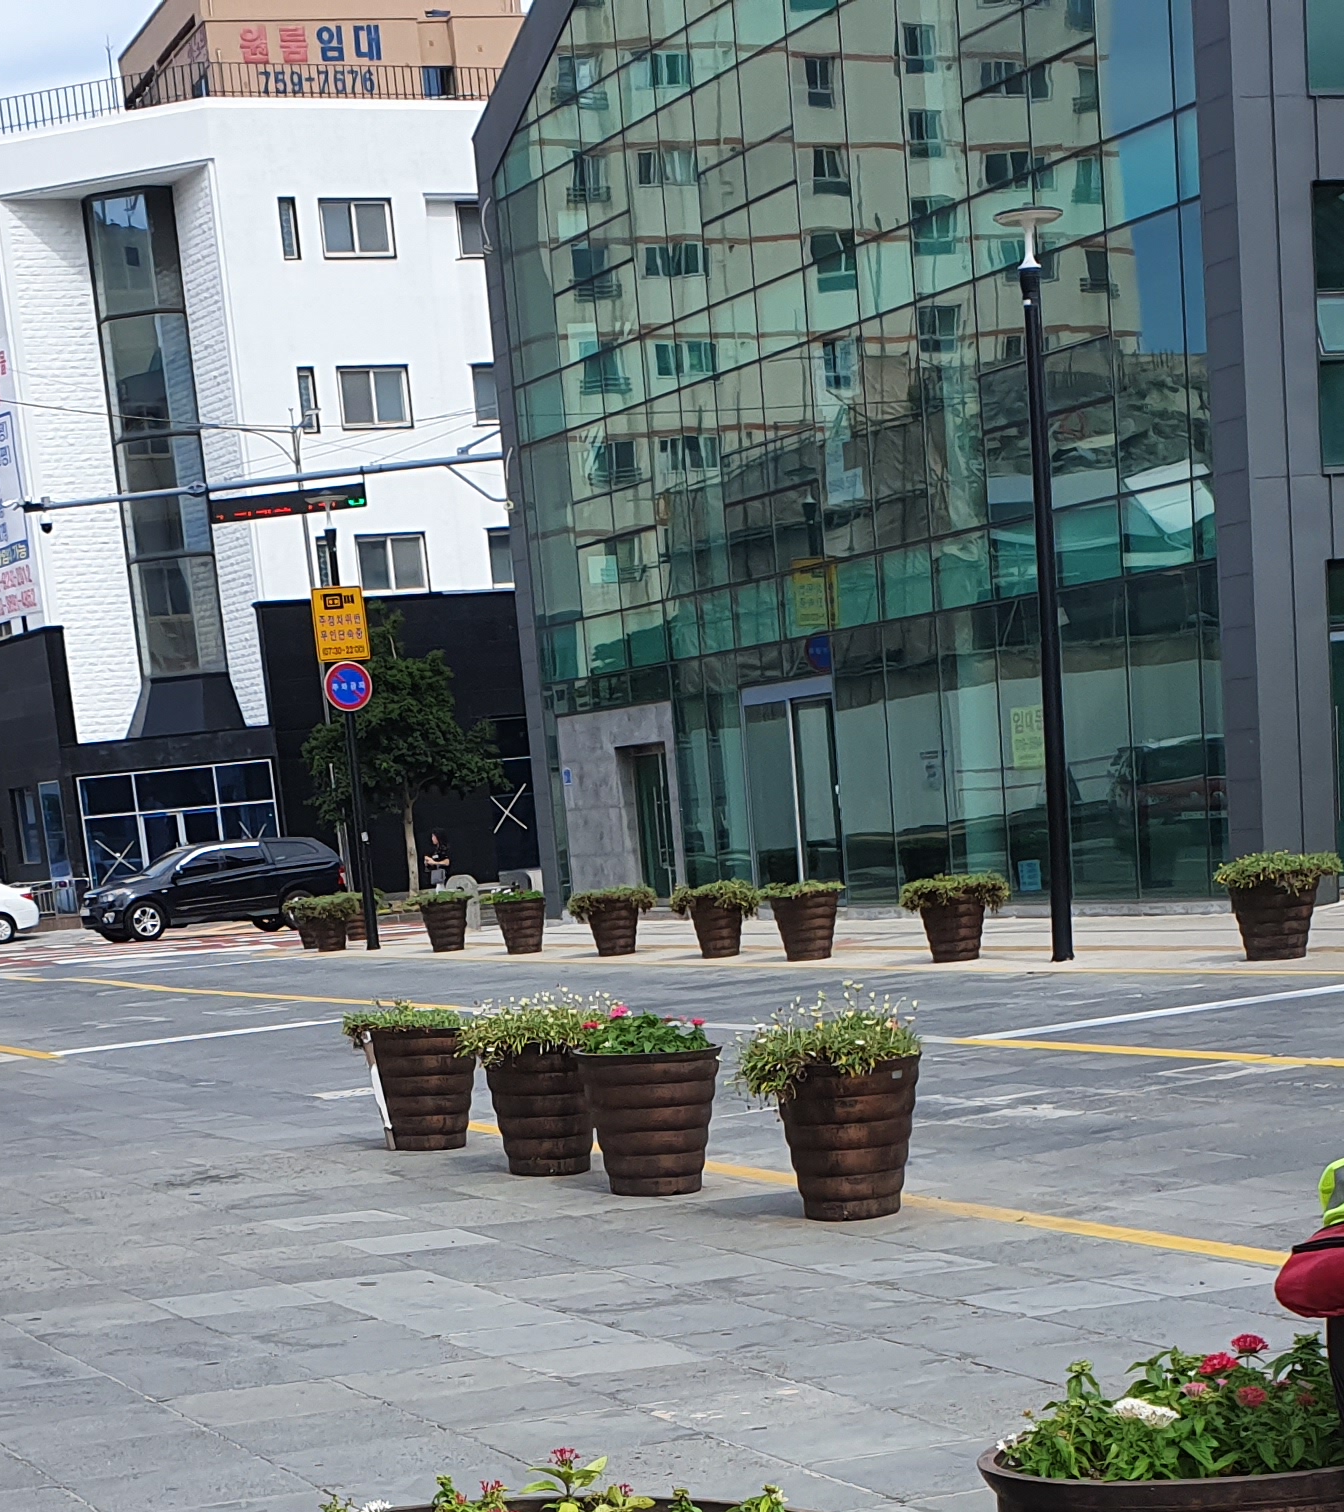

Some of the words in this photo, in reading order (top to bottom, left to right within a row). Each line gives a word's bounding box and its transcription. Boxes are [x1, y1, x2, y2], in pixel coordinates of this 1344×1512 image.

[258, 69, 375, 95] 759-7676
[318, 613, 361, 627] 주정차위반
[320, 627, 363, 641] 무인단속중
